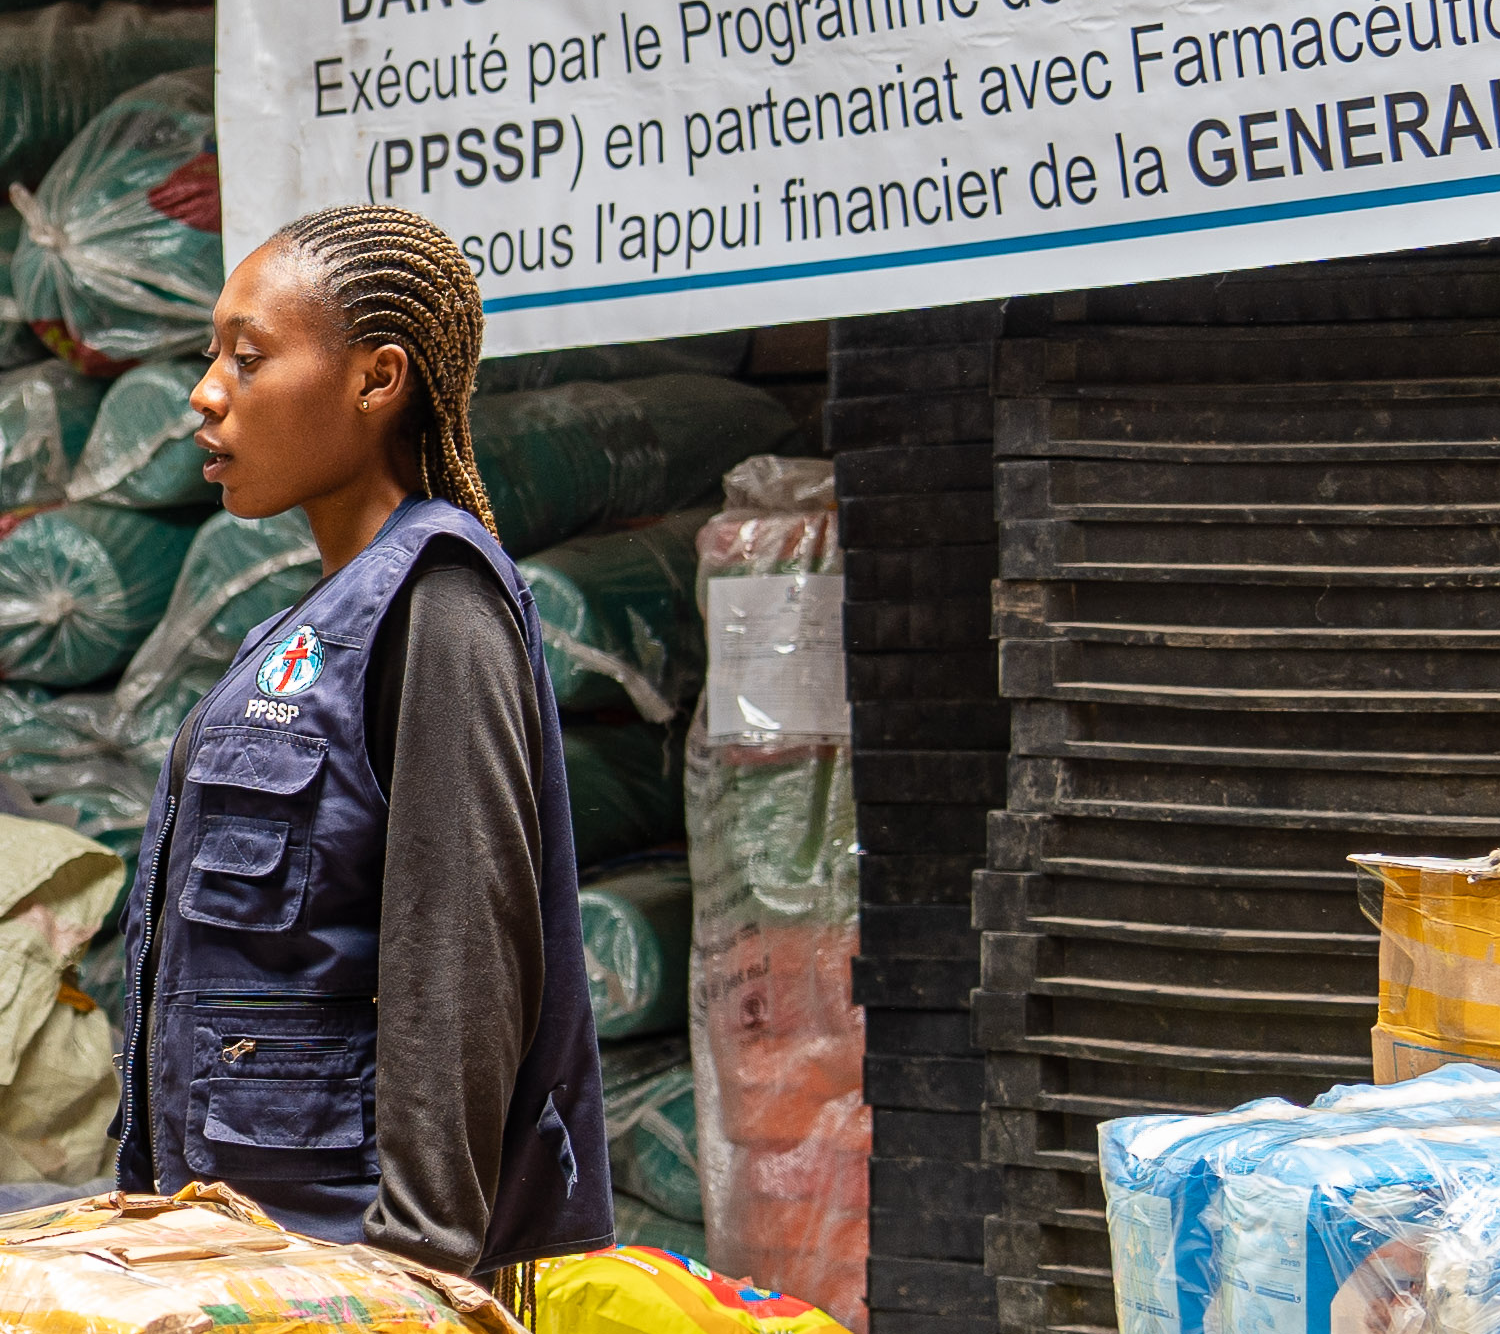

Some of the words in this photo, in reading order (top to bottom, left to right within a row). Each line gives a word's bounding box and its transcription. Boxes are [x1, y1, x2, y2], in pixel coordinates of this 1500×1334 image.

[314, 34, 508, 118] Exécuté
[528, 32, 607, 103] par
[620, 11, 662, 72] le
[366, 113, 585, 206] (PPSSP)
[604, 118, 664, 170] en
[684, 58, 961, 176] partenariat
[979, 49, 1112, 116] avec
[469, 216, 573, 279] sous
[595, 197, 762, 275] l'appui
[782, 166, 1007, 242] financier
[1028, 142, 1096, 211] de
[1116, 132, 1169, 201] la
[244, 699, 299, 724] PPSSP
